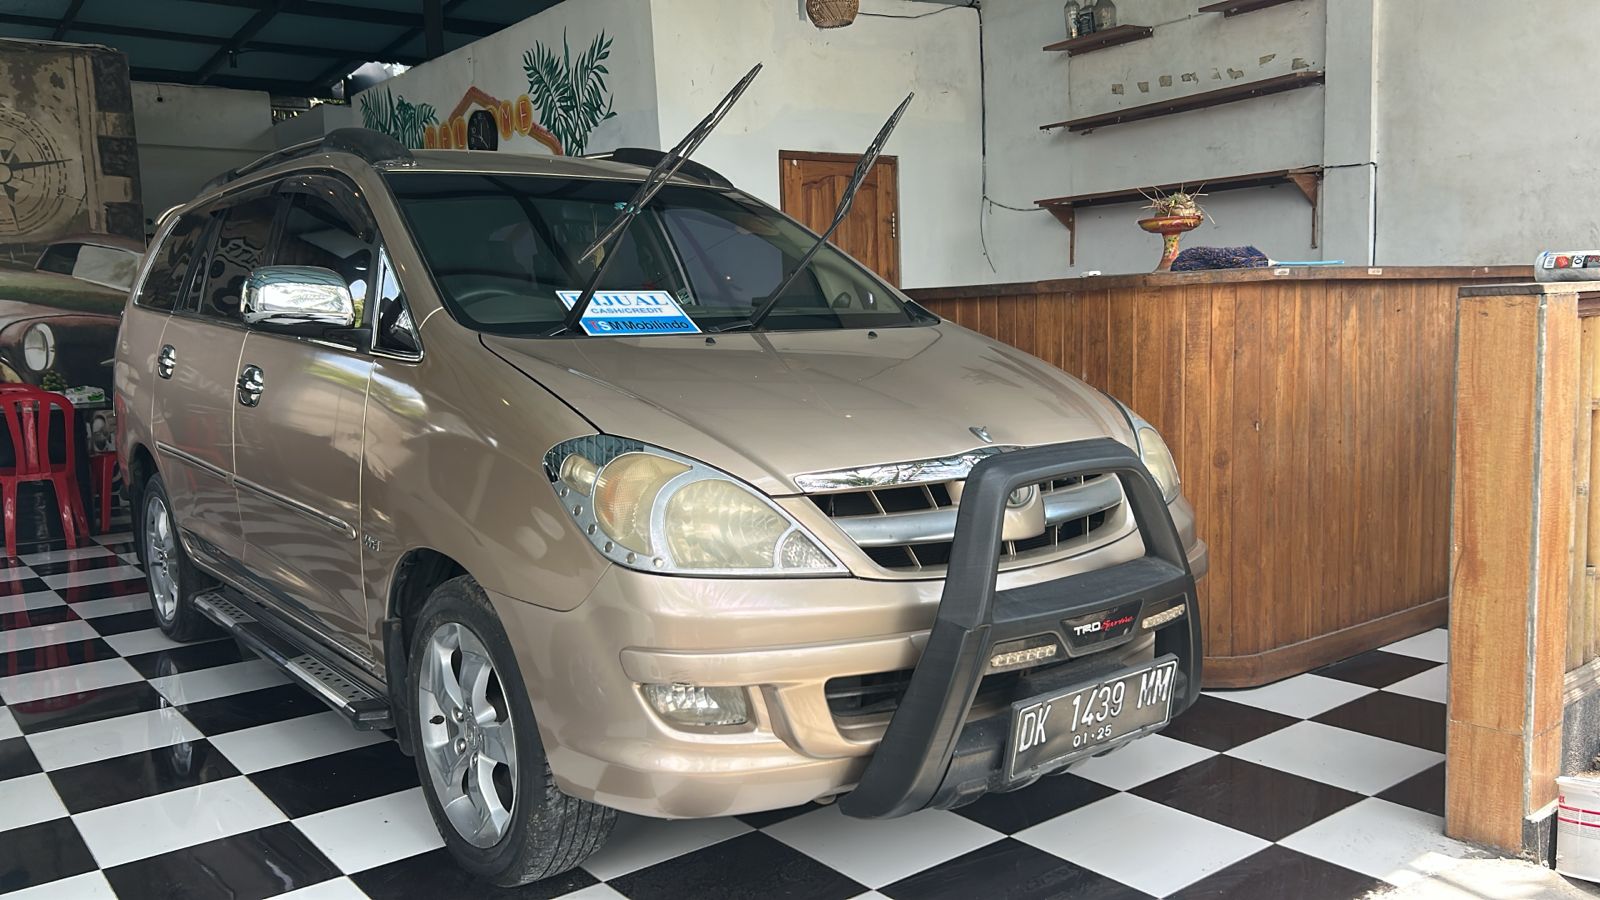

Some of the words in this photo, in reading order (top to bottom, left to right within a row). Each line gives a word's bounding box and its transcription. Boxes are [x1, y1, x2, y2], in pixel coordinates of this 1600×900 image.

[624, 319, 690, 331] Mobilindo
[1073, 620, 1101, 636] TRD
[1018, 705, 1052, 752] DK
[1071, 681, 1126, 732] 1439
[1136, 666, 1173, 709] MM
